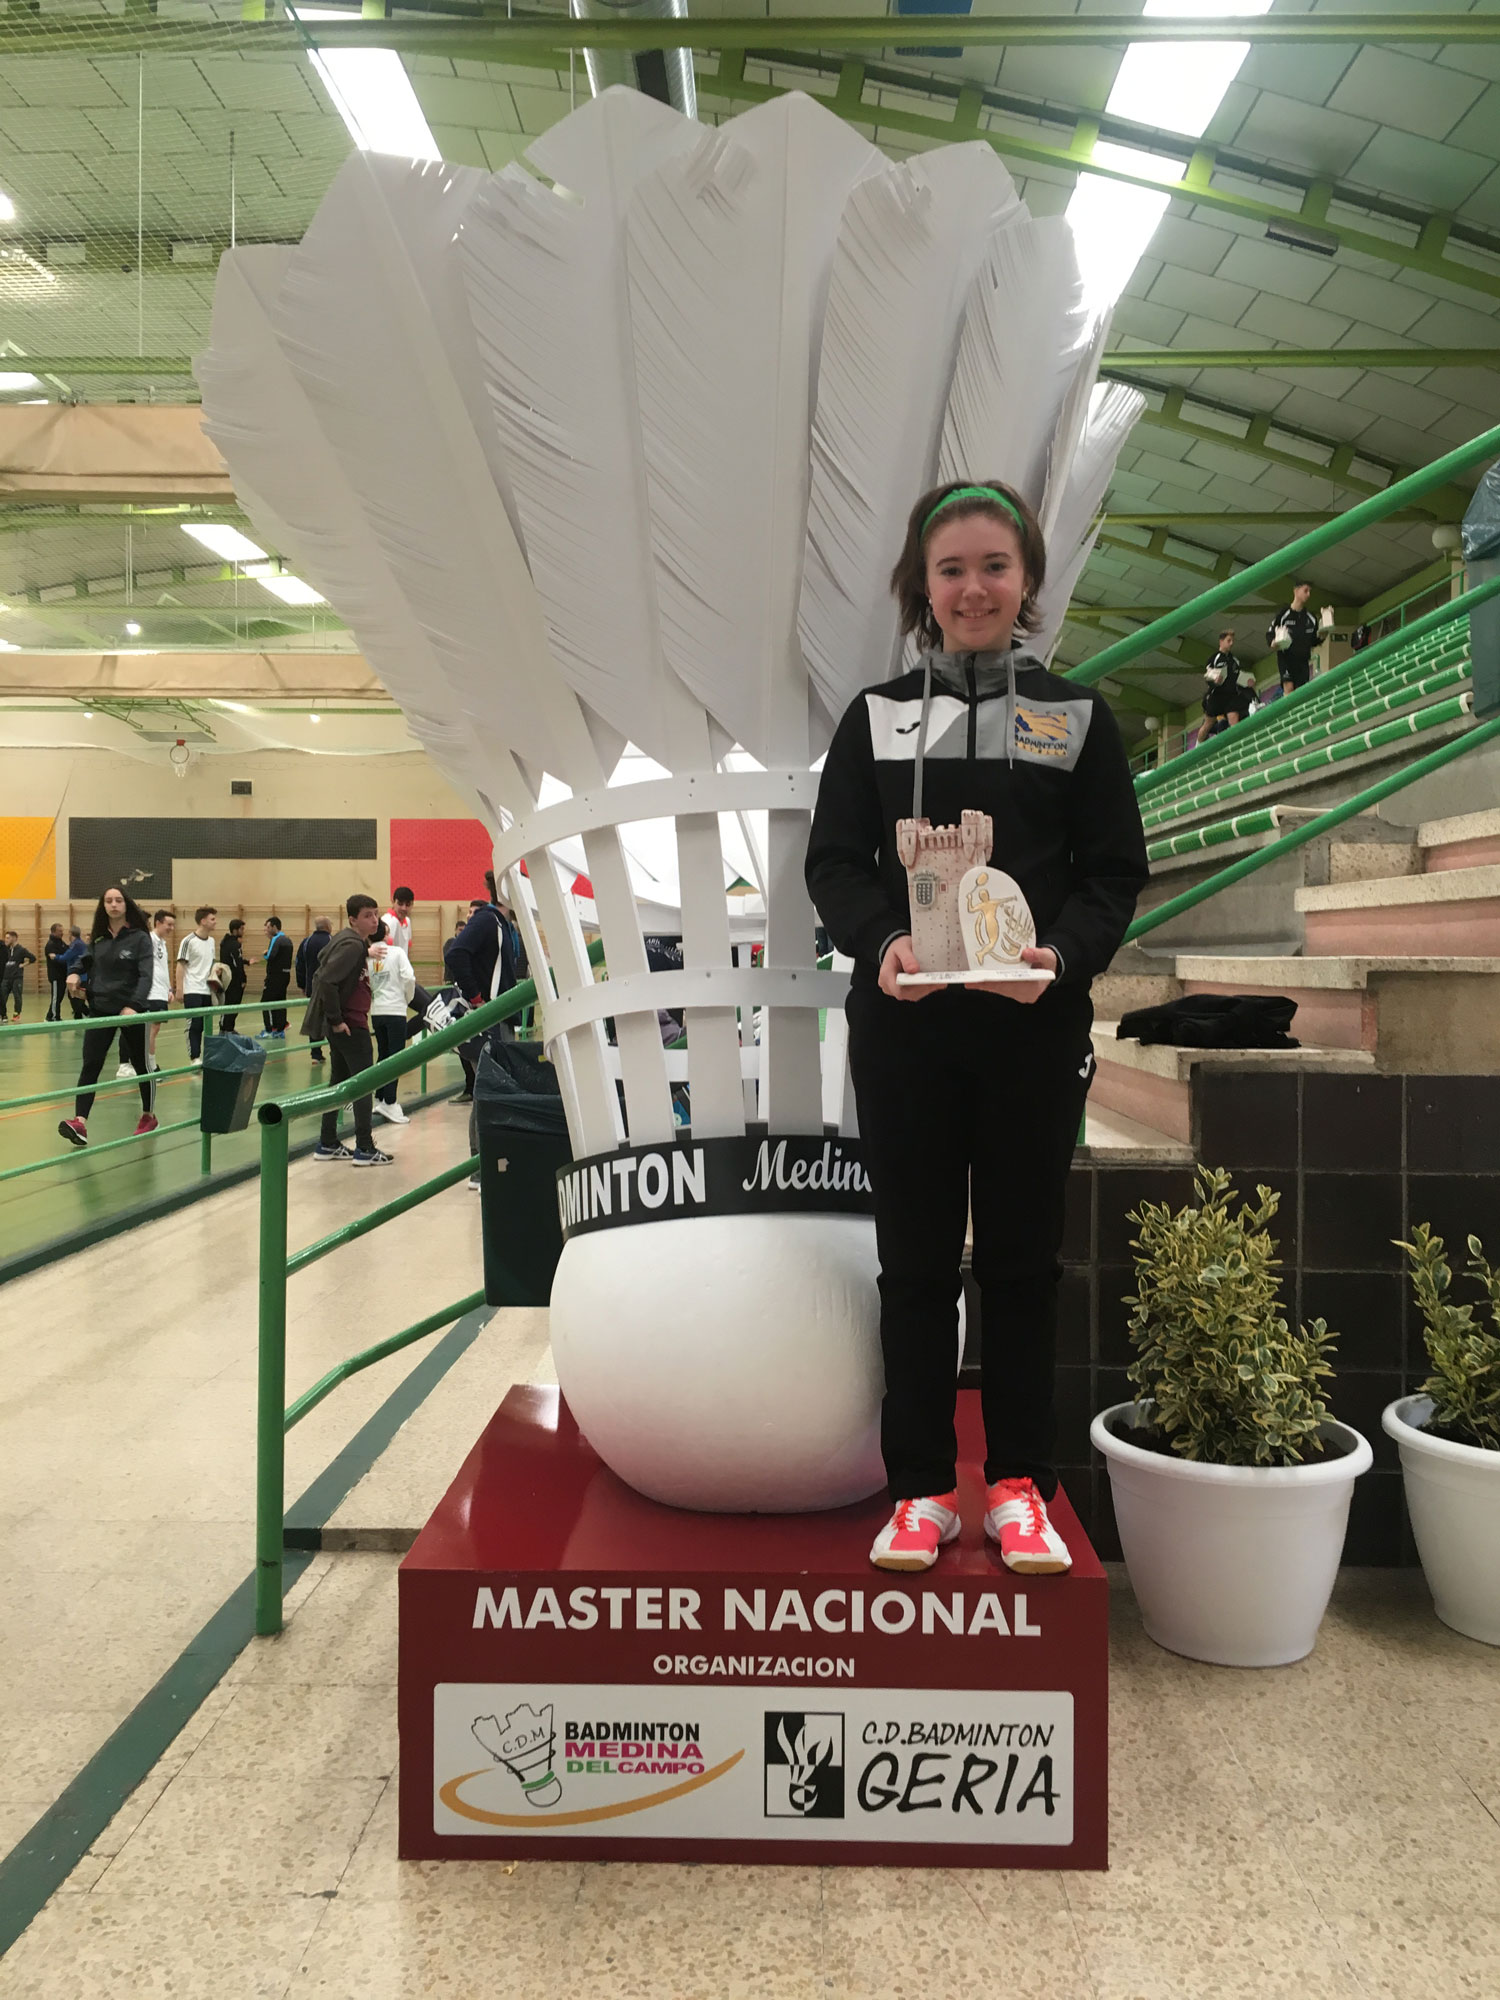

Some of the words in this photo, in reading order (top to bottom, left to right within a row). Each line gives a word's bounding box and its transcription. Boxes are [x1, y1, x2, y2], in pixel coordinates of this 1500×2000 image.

[472, 1587, 701, 1630] MASTER
[724, 1588, 1042, 1636] NACIONAL
[653, 1654, 855, 1678] ORGANIZACION
[565, 1722, 700, 1741] BADMINTON
[565, 1742, 704, 1759] MEDINA
[857, 1751, 1061, 1816] GERIA
